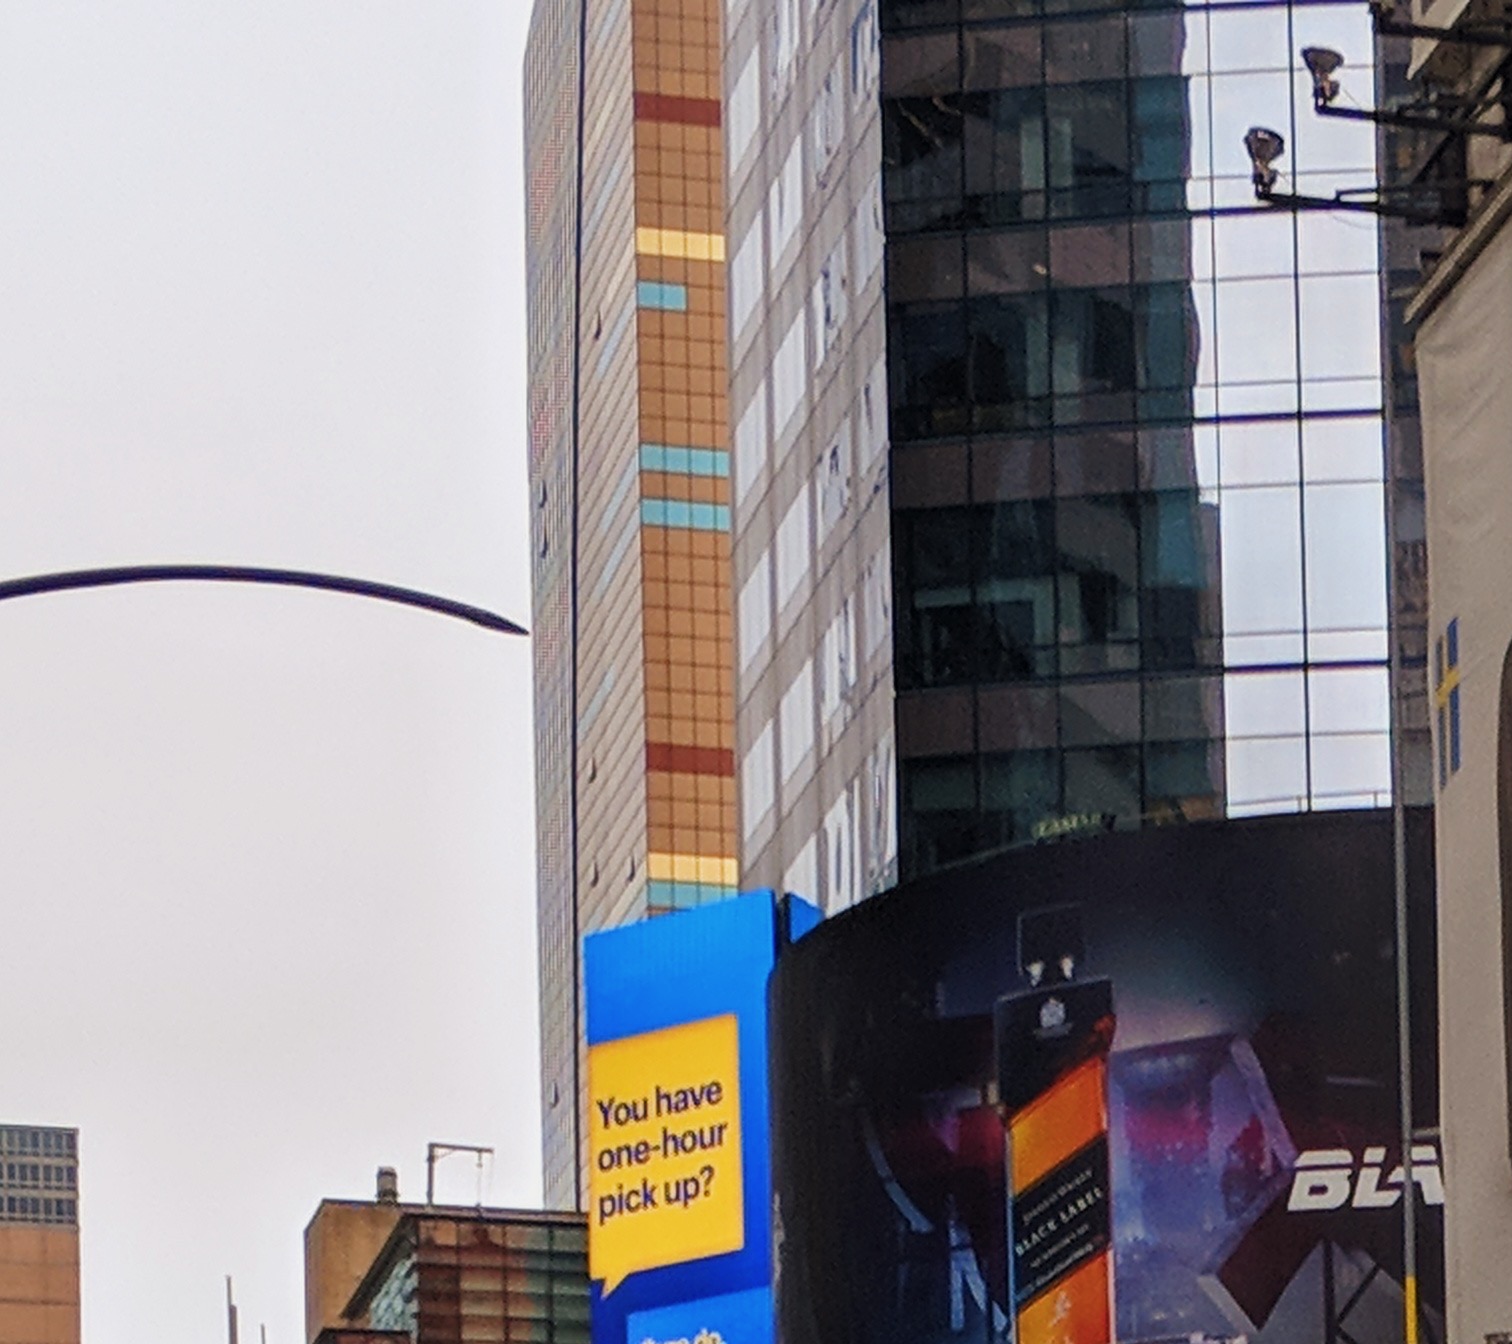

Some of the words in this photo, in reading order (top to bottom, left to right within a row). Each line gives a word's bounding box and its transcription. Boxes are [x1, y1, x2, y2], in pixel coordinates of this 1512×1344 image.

[597, 1096, 648, 1130] You
[655, 1080, 723, 1118] have
[598, 1122, 728, 1172] one-hour
[599, 1178, 658, 1227] pick
[664, 1164, 715, 1209] up?
